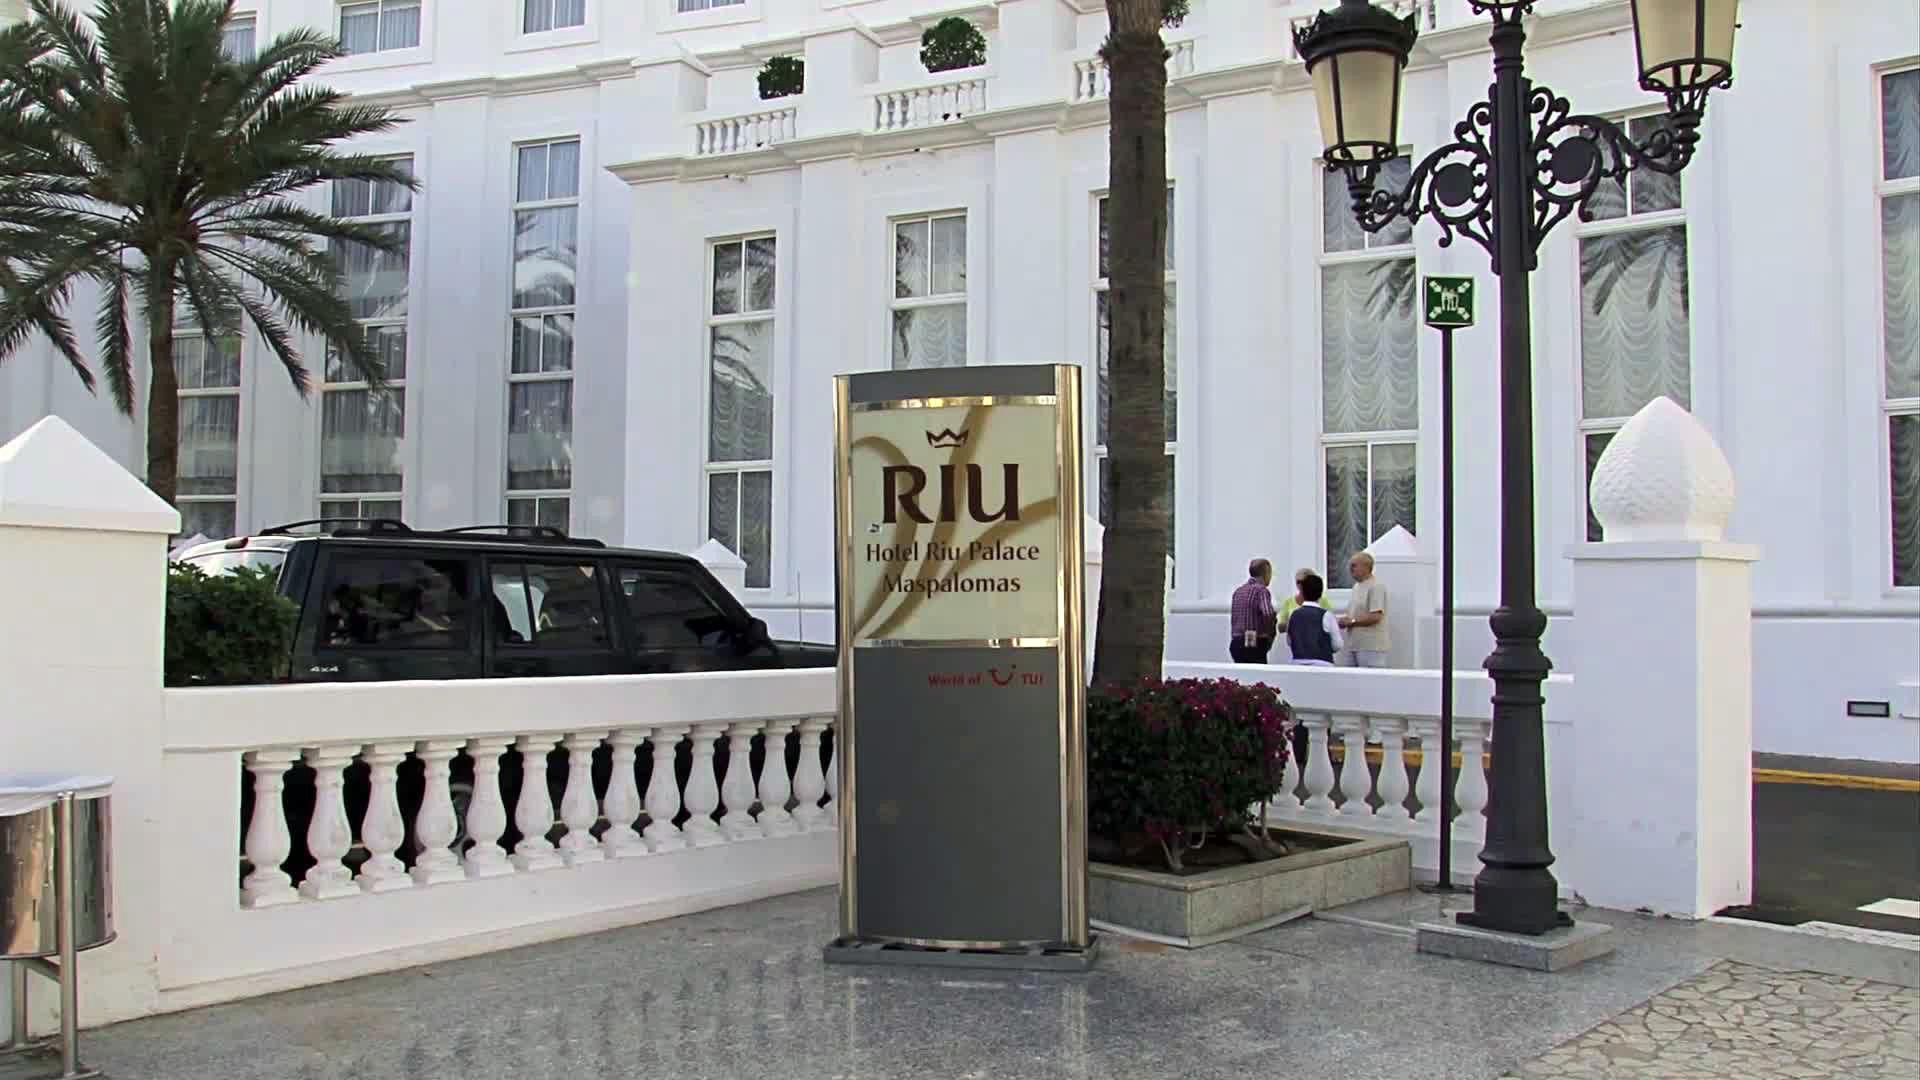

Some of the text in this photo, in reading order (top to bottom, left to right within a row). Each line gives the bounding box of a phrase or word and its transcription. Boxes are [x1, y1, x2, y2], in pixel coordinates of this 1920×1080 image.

[882, 463, 1020, 524] RIU
[866, 541, 1040, 562] Hotel Riu Palace
[882, 574, 1021, 599] Maspalomas
[928, 673, 964, 686] World
[1022, 672, 1043, 685] TUI
